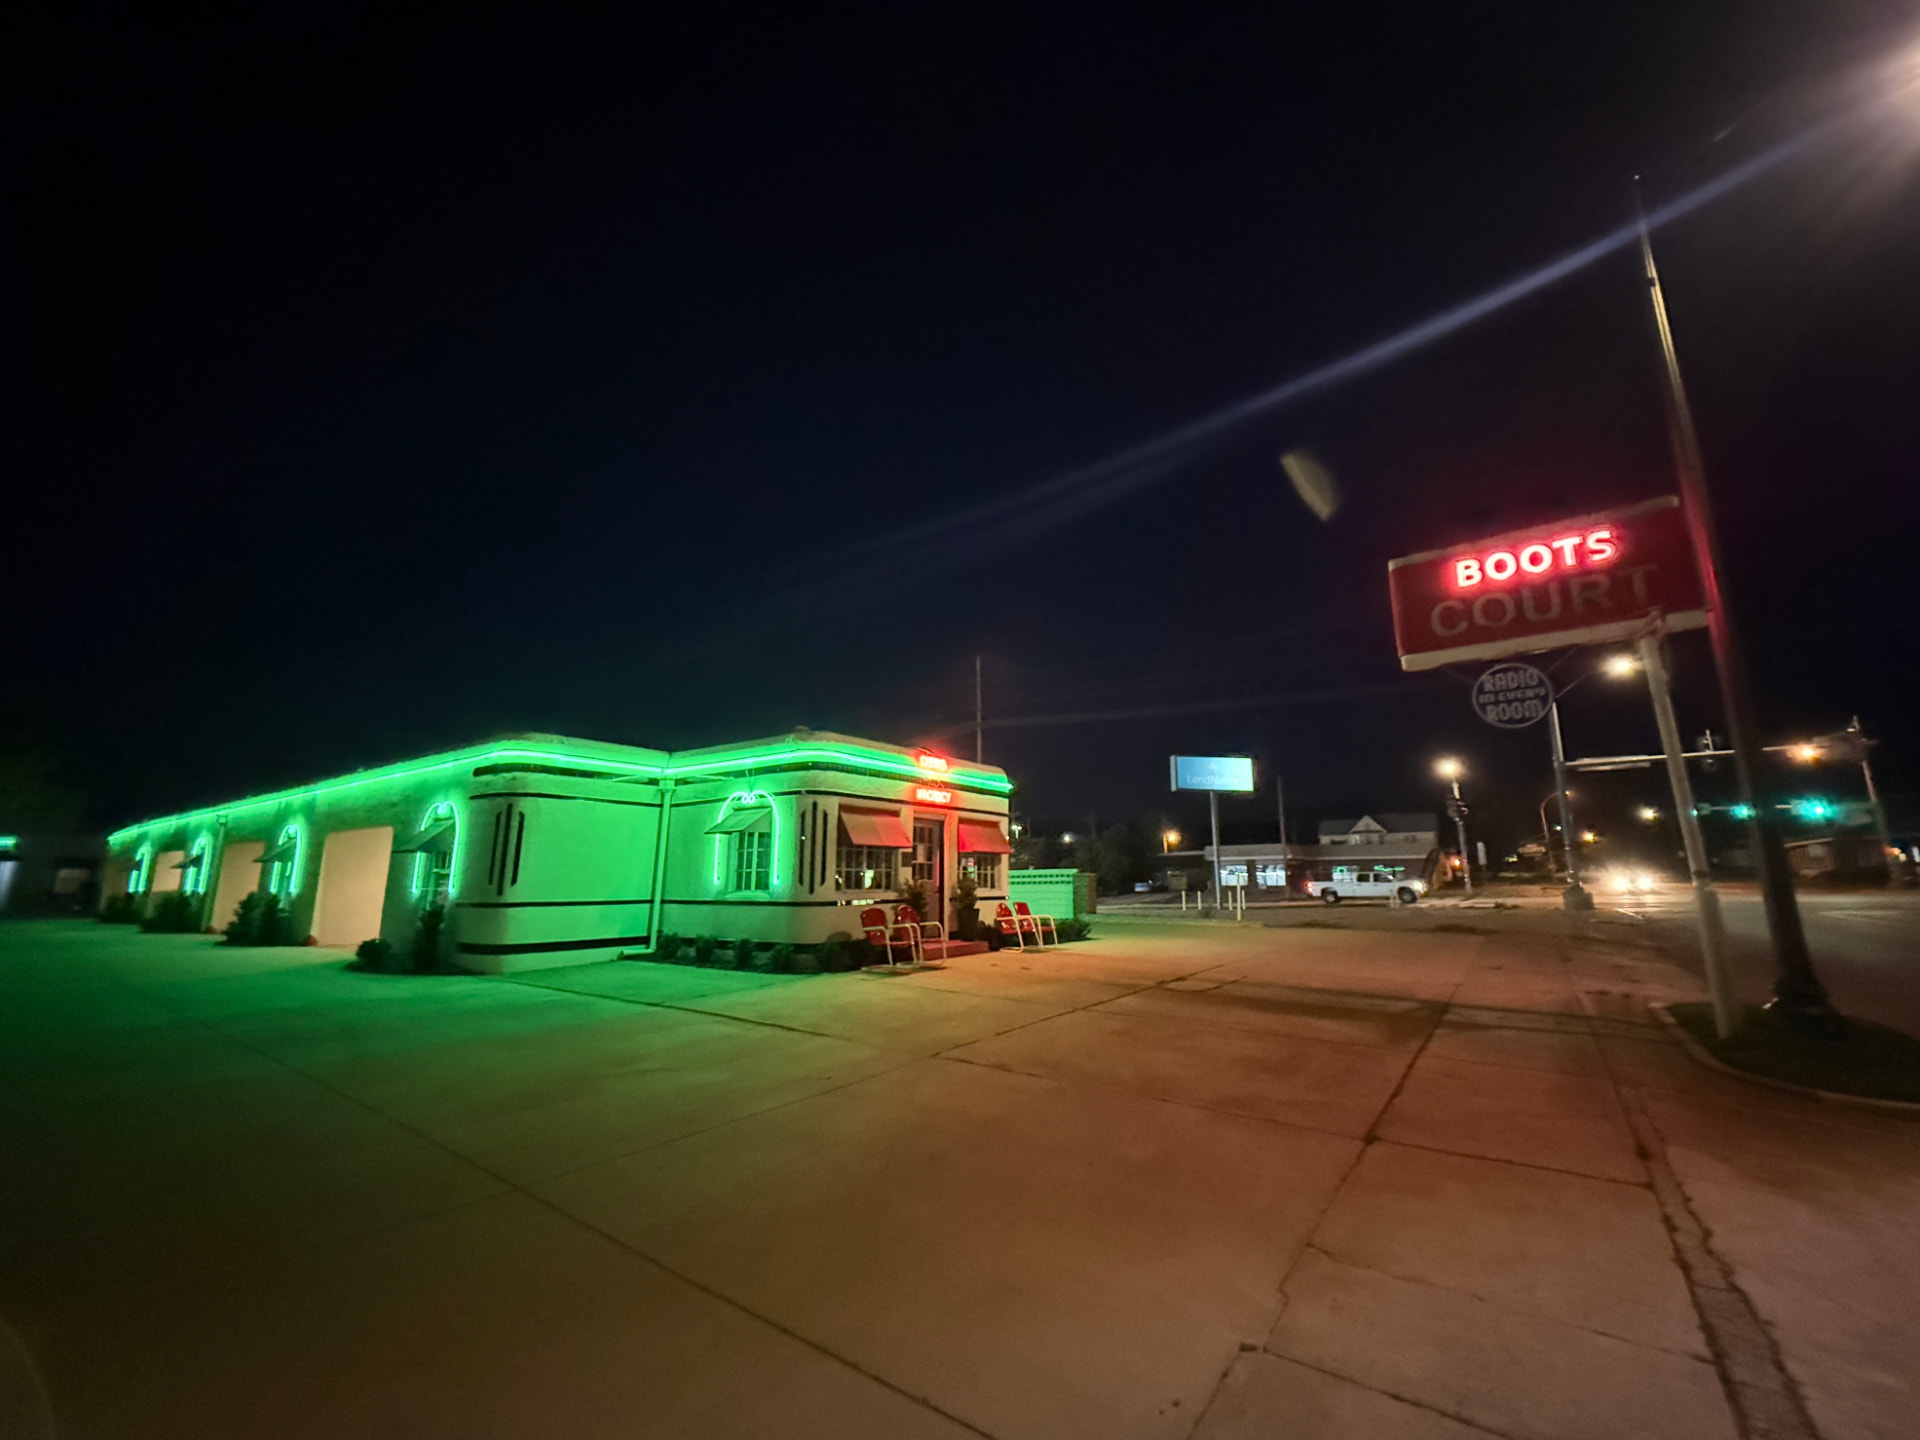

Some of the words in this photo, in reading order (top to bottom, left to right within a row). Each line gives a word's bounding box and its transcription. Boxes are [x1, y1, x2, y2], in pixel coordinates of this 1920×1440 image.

[1455, 529, 1616, 588] BOOTS
[1430, 564, 1657, 637] COURT
[1482, 668, 1540, 692] RADIO
[1486, 700, 1542, 723] ROOM
